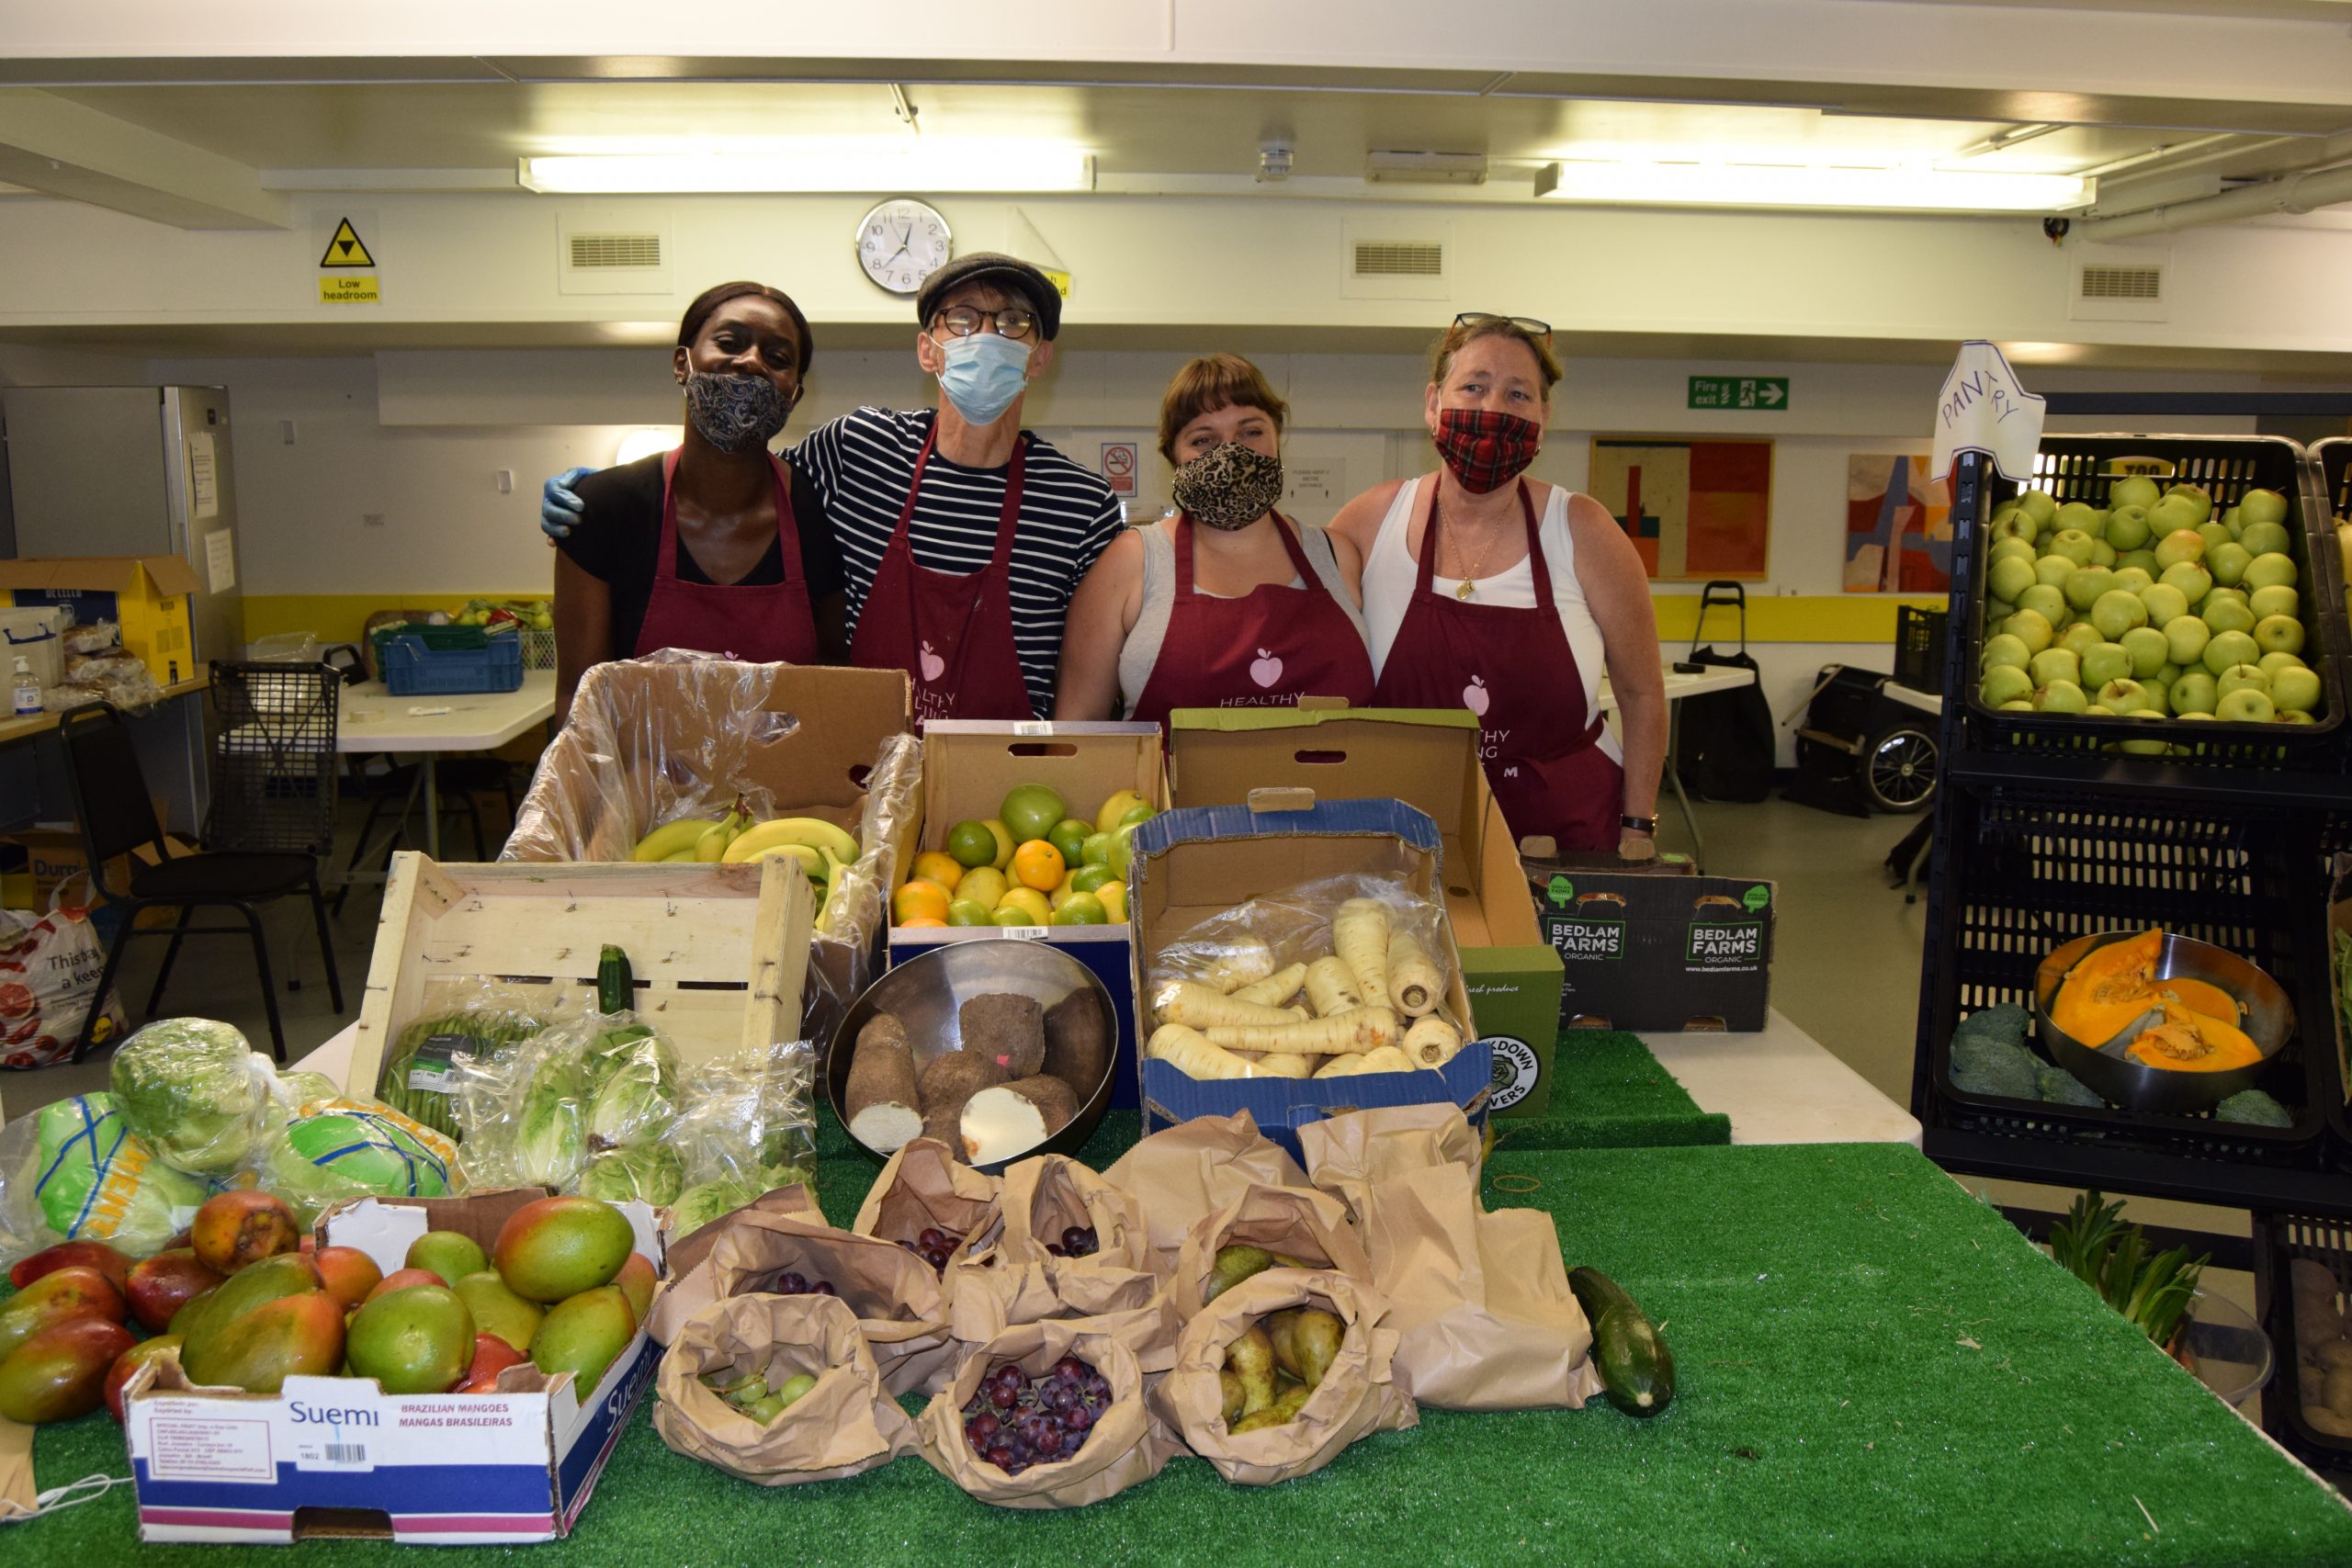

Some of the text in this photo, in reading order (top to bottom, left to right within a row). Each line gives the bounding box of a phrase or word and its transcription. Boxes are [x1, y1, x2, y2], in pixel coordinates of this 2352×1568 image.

[872, 224, 884, 236] 10
[928, 223, 938, 235] 2
[865, 241, 876, 253] 9
[935, 240, 944, 252] 3
[872, 258, 882, 270] 8
[930, 257, 938, 268] 4
[885, 270, 895, 281] 7
[901, 273, 911, 285] 6
[338, 279, 360, 288] Low
[323, 290, 378, 300] headroom
[1695, 380, 1718, 391] Fire
[1695, 394, 1716, 404] exit
[1942, 370, 2019, 430] PANTRY
[1219, 692, 1306, 708] HEALTHY
[1552, 924, 1620, 938] BEDLAM
[1693, 928, 1758, 941] BEDLAM
[1552, 936, 1619, 953] FARMS
[1692, 940, 1757, 954] FARMS
[47, 952, 81, 971] This
[1564, 953, 1604, 961] ORGANIC
[62, 978, 71, 989] a
[1486, 984, 1520, 995] produce
[607, 1342, 652, 1434] Suemi
[289, 1401, 379, 1427] Suemi
[401, 1404, 509, 1413] BRAZILIAN MANGOES
[399, 1417, 513, 1427] MANGAS BRASILEIRAS
